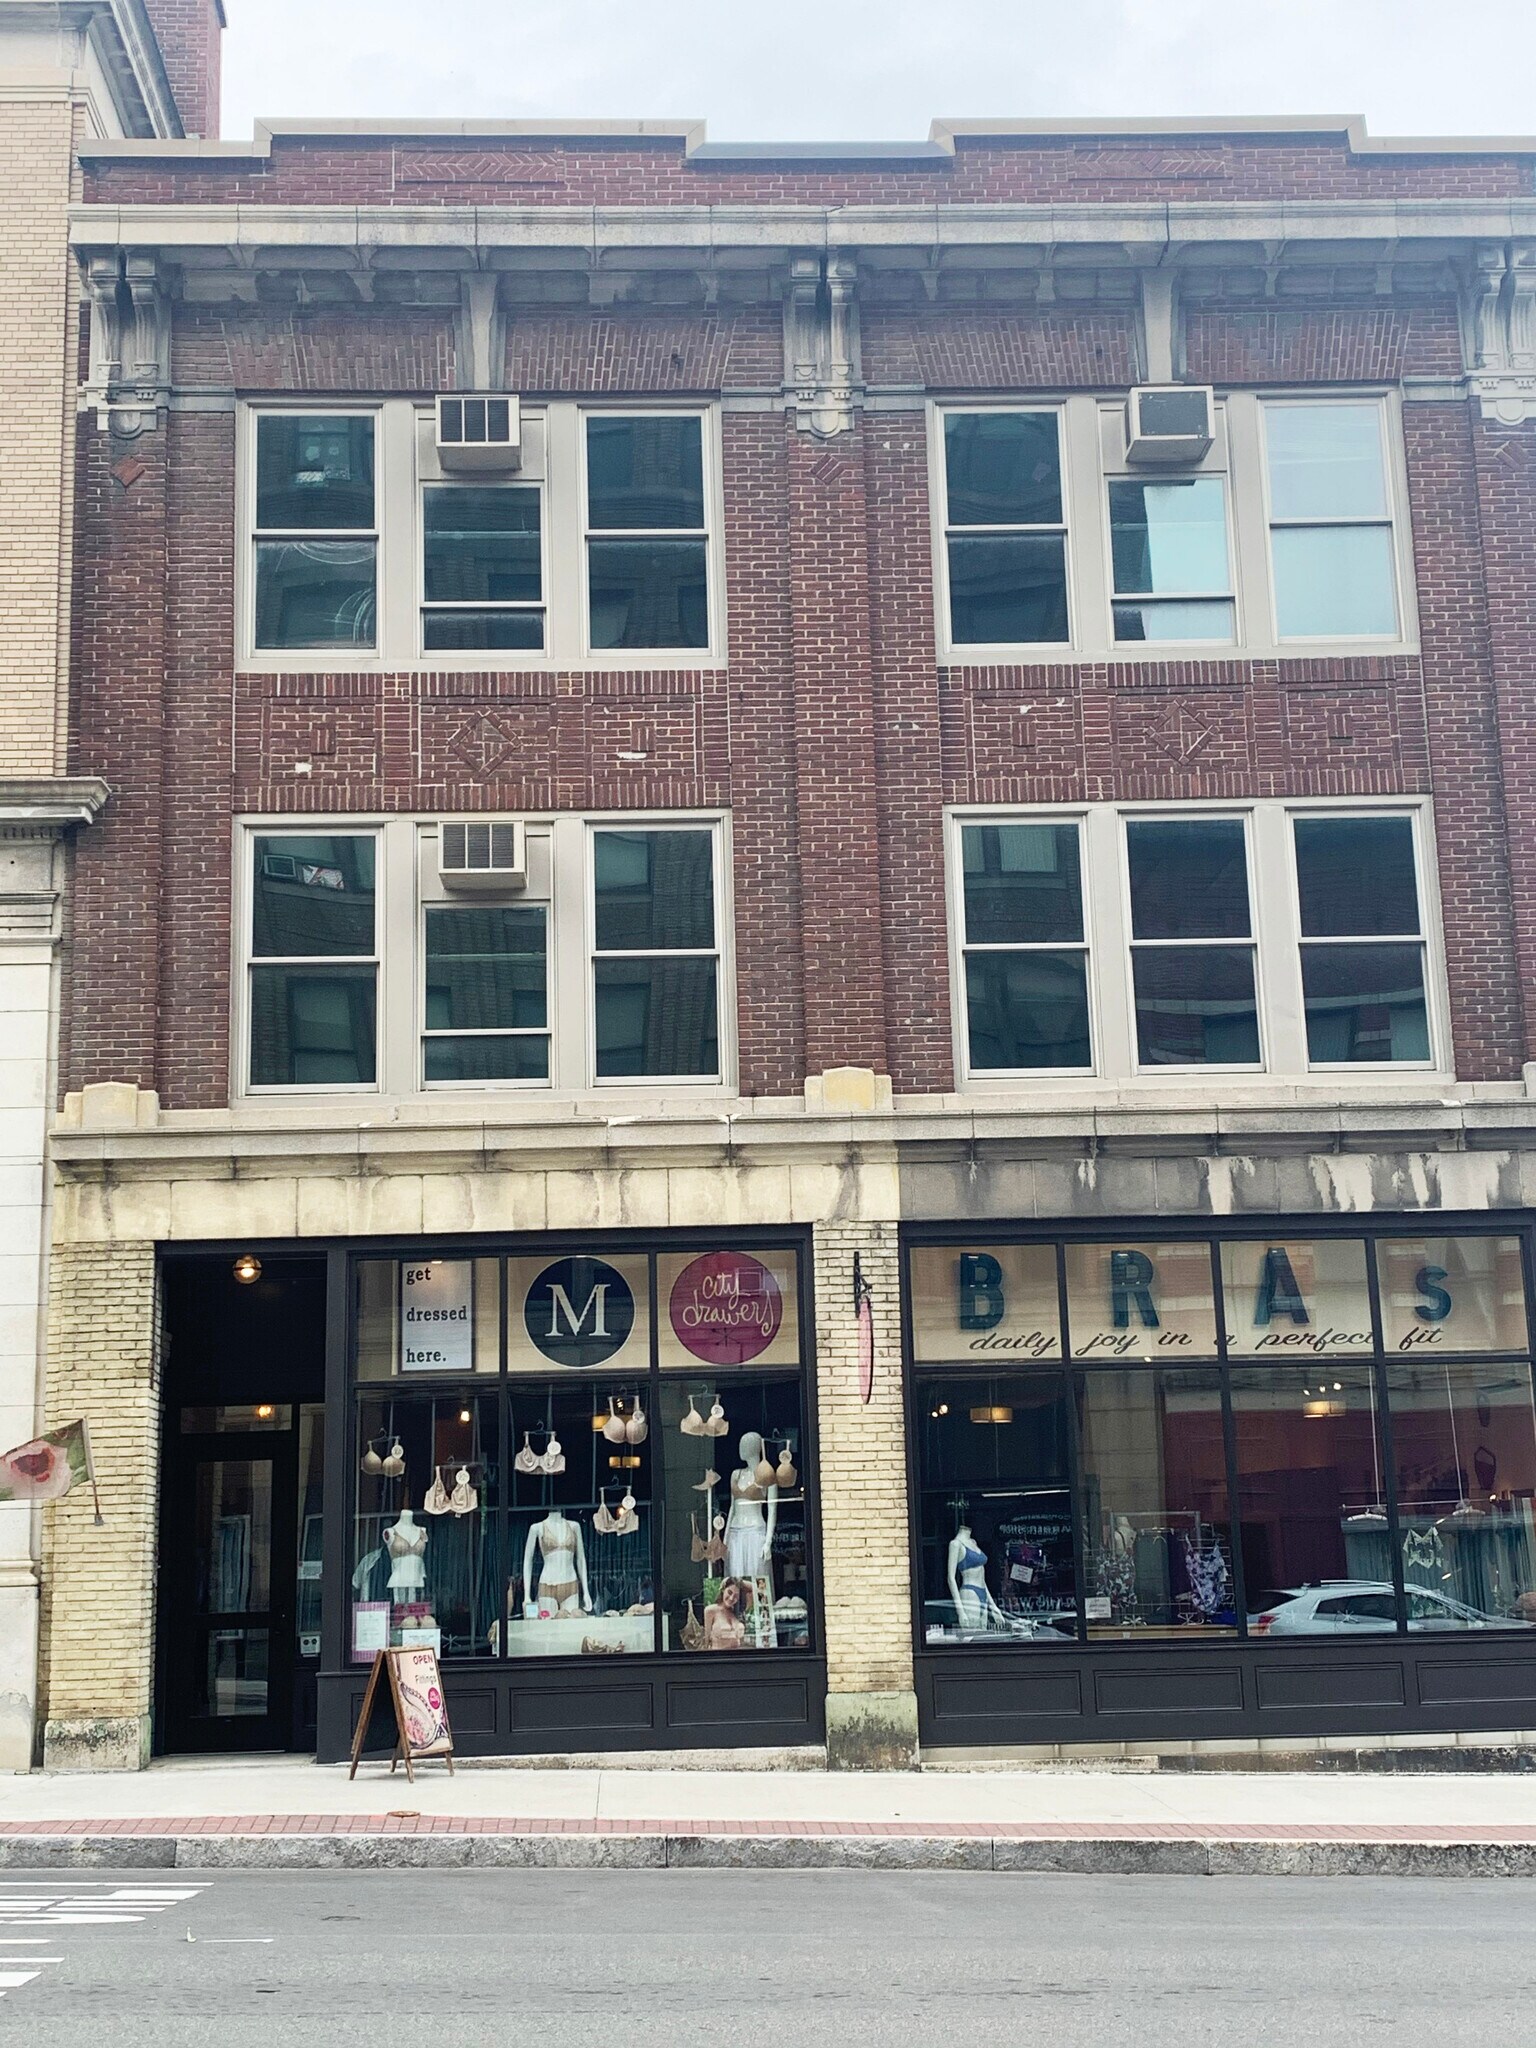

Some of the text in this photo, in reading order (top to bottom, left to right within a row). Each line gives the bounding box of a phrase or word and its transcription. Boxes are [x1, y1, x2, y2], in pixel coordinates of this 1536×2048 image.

[406, 1267, 431, 1285] get
[406, 1305, 467, 1322] dressed
[545, 1284, 611, 1337] M
[969, 1331, 1058, 1357] daily
[1075, 1332, 1140, 1357] joy
[1158, 1331, 1193, 1346] in
[1255, 1328, 1375, 1352] perfect
[1398, 1327, 1443, 1350] fit
[406, 1347, 447, 1363] here.
[413, 1653, 433, 1666] OPEN
